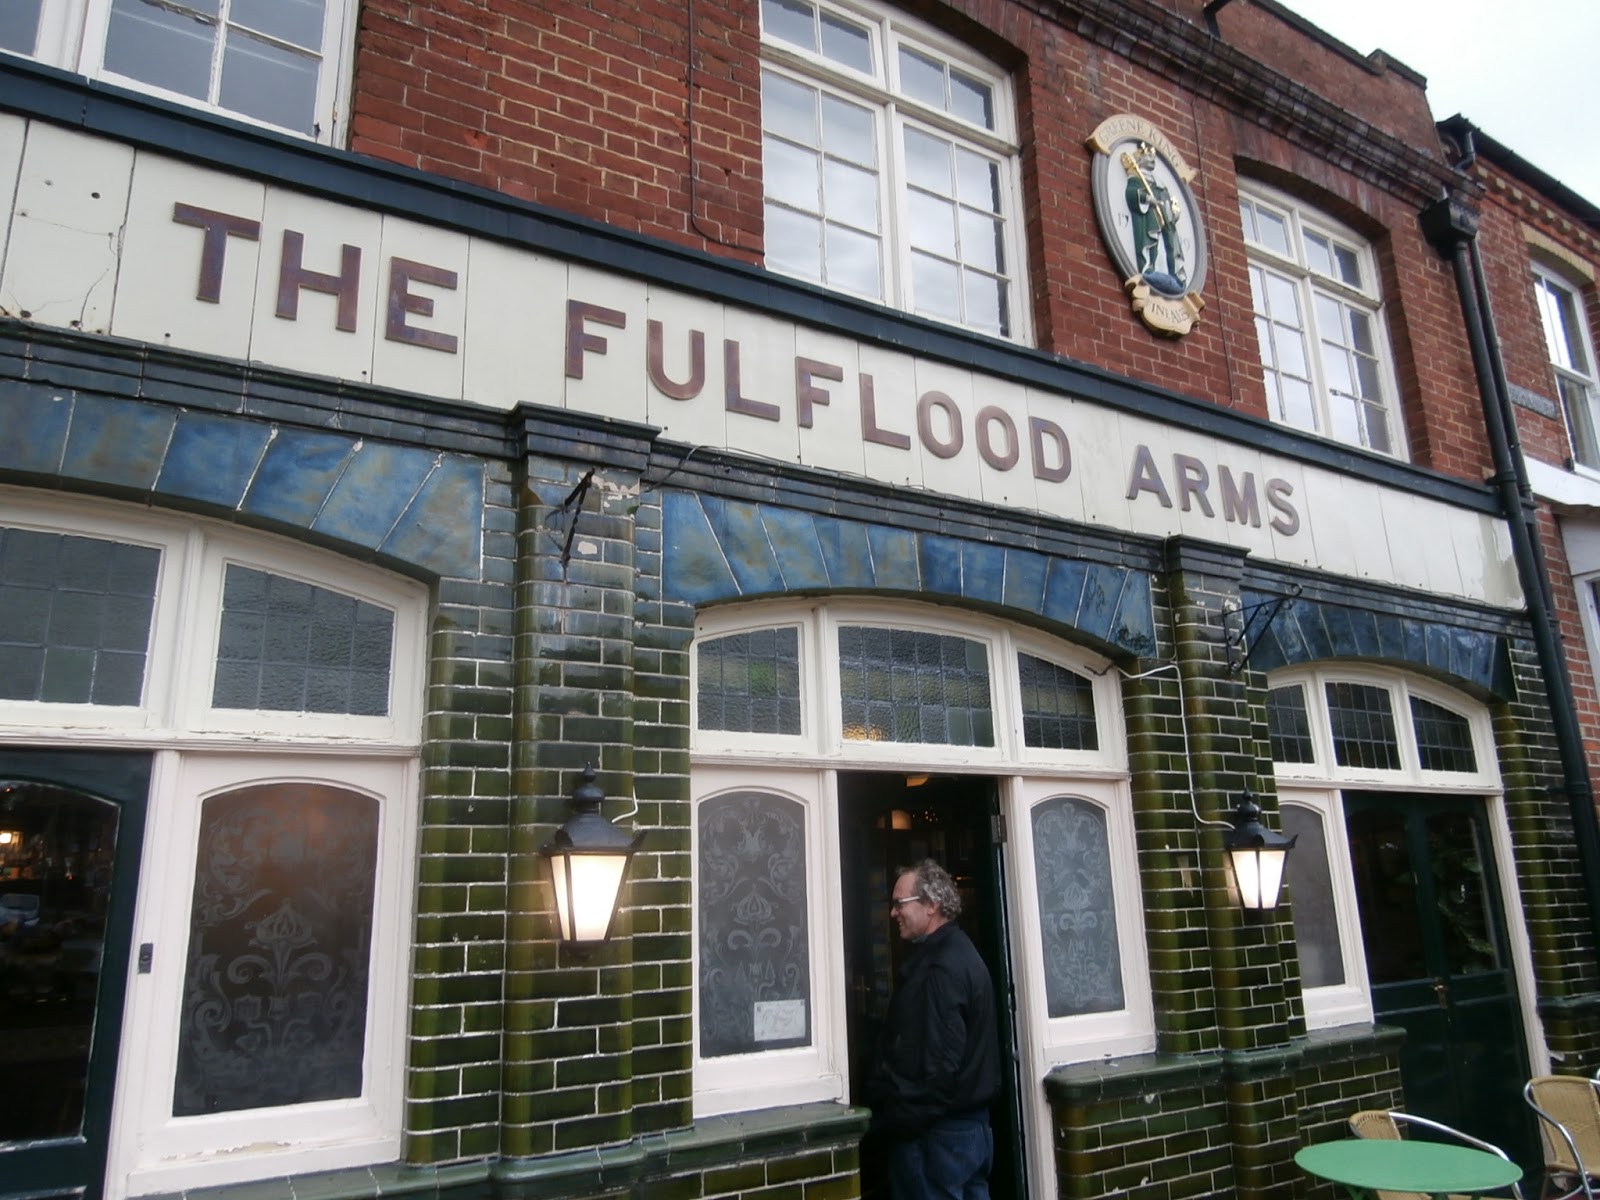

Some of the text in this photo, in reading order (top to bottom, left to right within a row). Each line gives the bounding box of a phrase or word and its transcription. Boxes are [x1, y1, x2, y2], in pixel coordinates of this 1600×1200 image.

[1099, 119, 1181, 167] GREENE KING
[173, 201, 1301, 536] THE FULFLOOD ARMS
